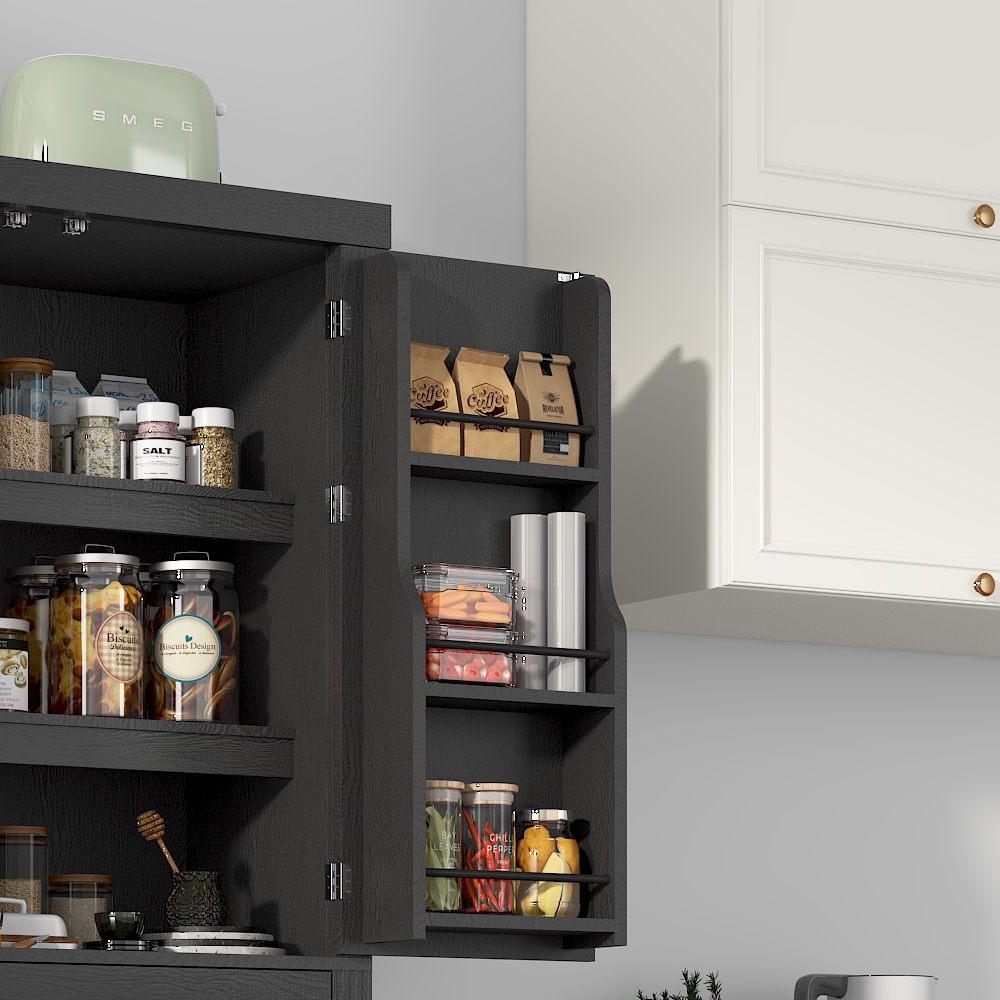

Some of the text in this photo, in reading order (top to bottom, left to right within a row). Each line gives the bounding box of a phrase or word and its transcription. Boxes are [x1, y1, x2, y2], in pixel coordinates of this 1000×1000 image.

[92, 109, 193, 132] SMEG
[410, 384, 450, 403] Coffee
[467, 391, 510, 410] Coffee
[106, 632, 140, 644] Biscuits
[159, 641, 216, 651] Biscuits Design
[441, 831, 457, 839] BAY
[433, 842, 461, 852] LEAVES
